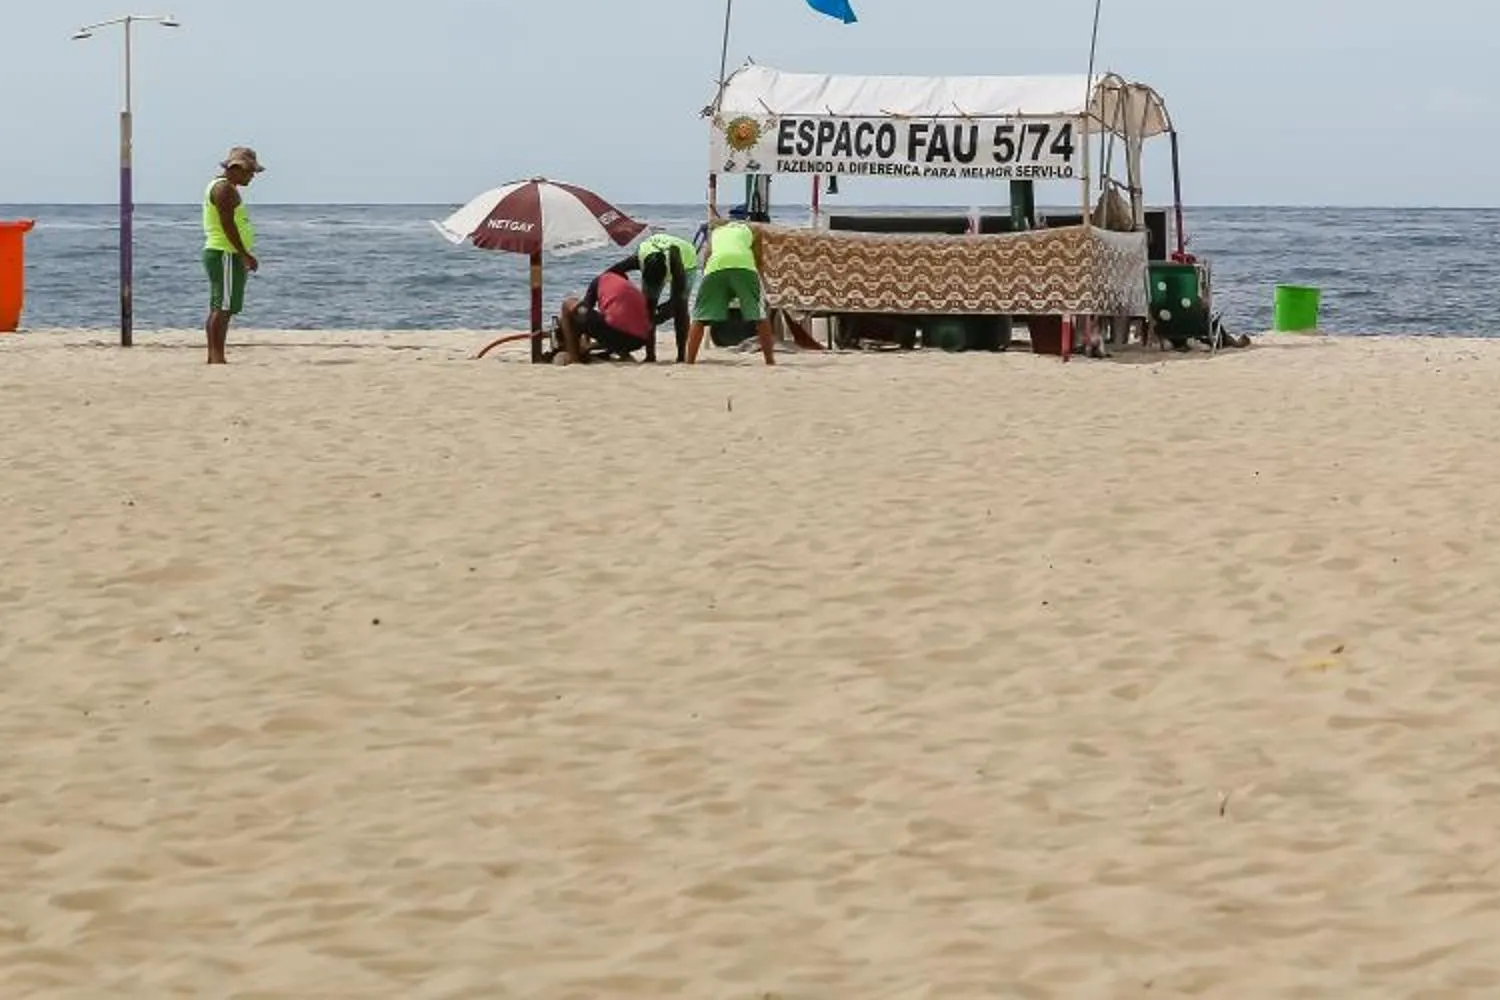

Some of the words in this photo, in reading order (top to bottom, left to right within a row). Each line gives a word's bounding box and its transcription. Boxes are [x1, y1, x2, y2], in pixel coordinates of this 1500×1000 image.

[907, 123, 979, 164] FAU
[992, 122, 1075, 163] 5/74
[777, 160, 833, 173] FAZENDO
[838, 161, 846, 173] A
[923, 166, 957, 178] PARA
[960, 166, 1013, 178] MELHOR
